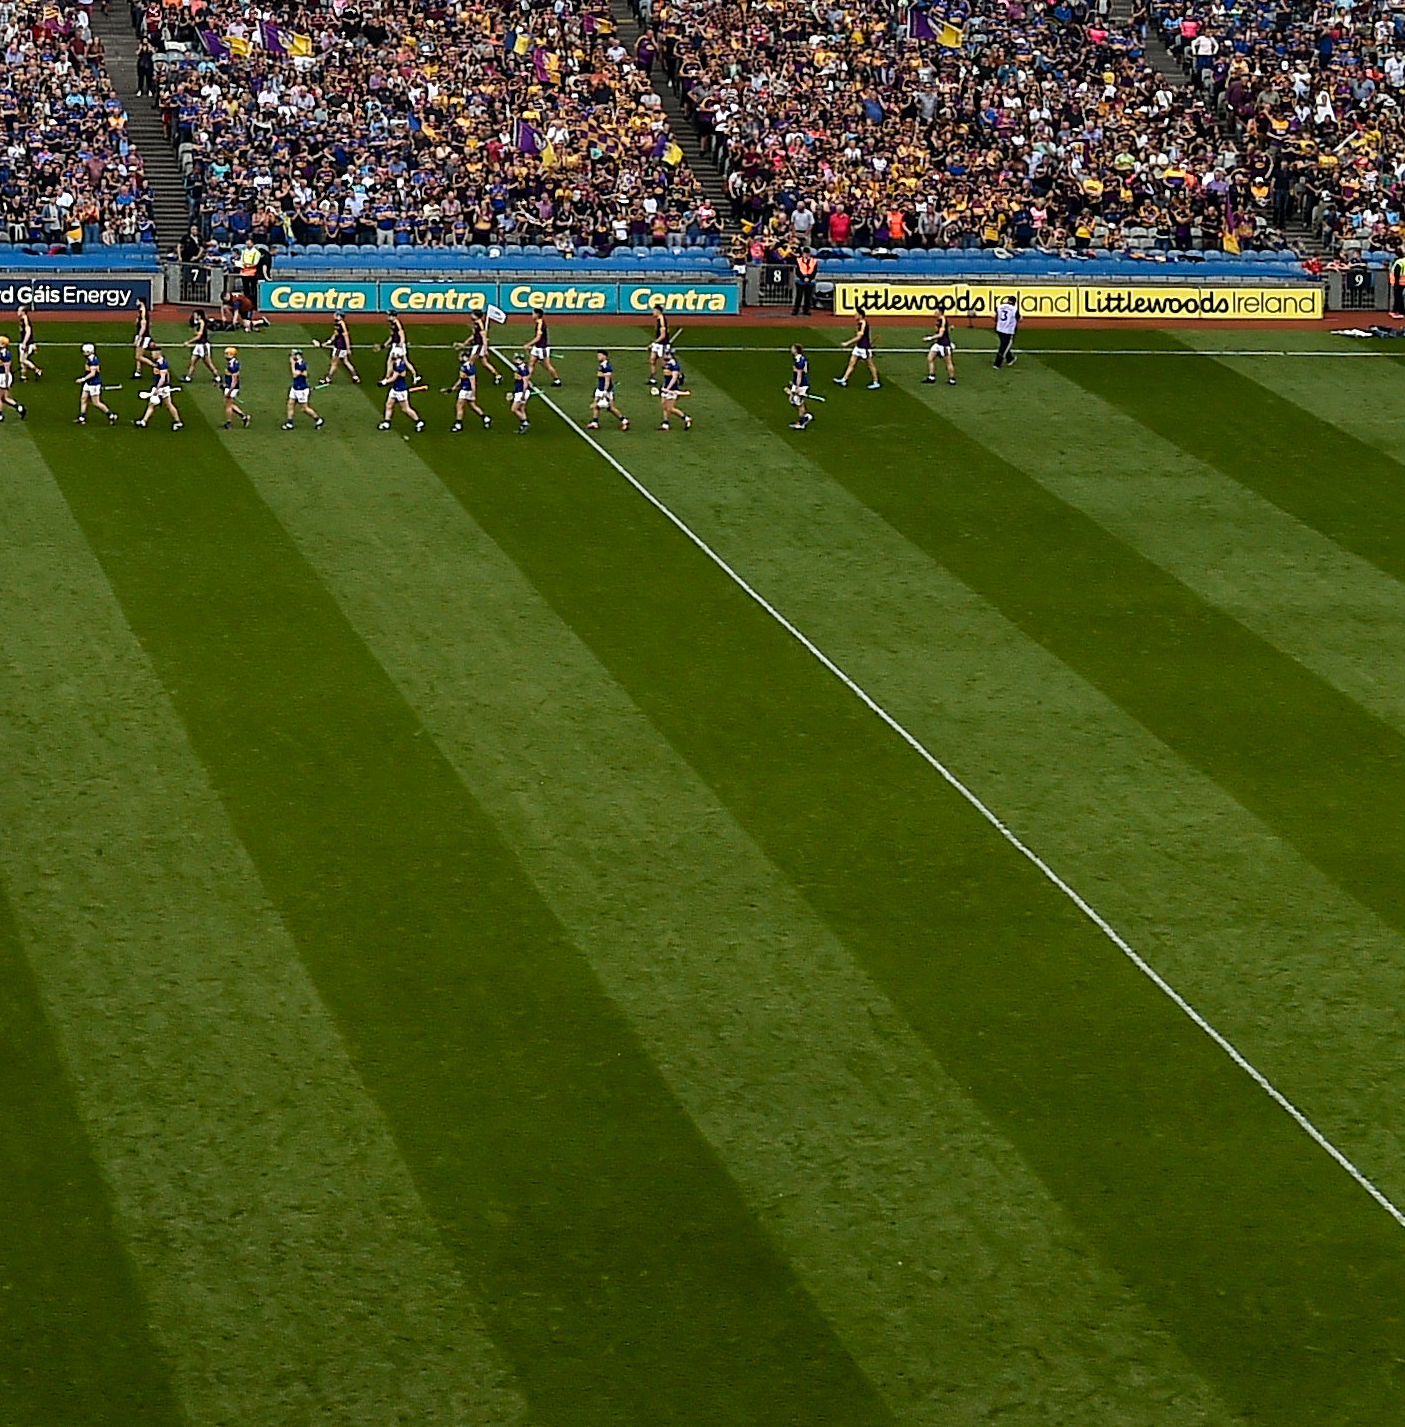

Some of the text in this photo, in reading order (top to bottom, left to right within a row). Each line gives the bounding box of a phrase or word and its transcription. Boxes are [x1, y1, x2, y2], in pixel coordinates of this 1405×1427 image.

[192, 269, 198, 281] 7
[774, 270, 781, 282] 8
[1355, 275, 1363, 286] 9
[17, 284, 59, 304] Gáis
[64, 286, 131, 306] Energy
[271, 287, 365, 308] Centra
[391, 288, 485, 309] Centra
[630, 288, 726, 310] Centra
